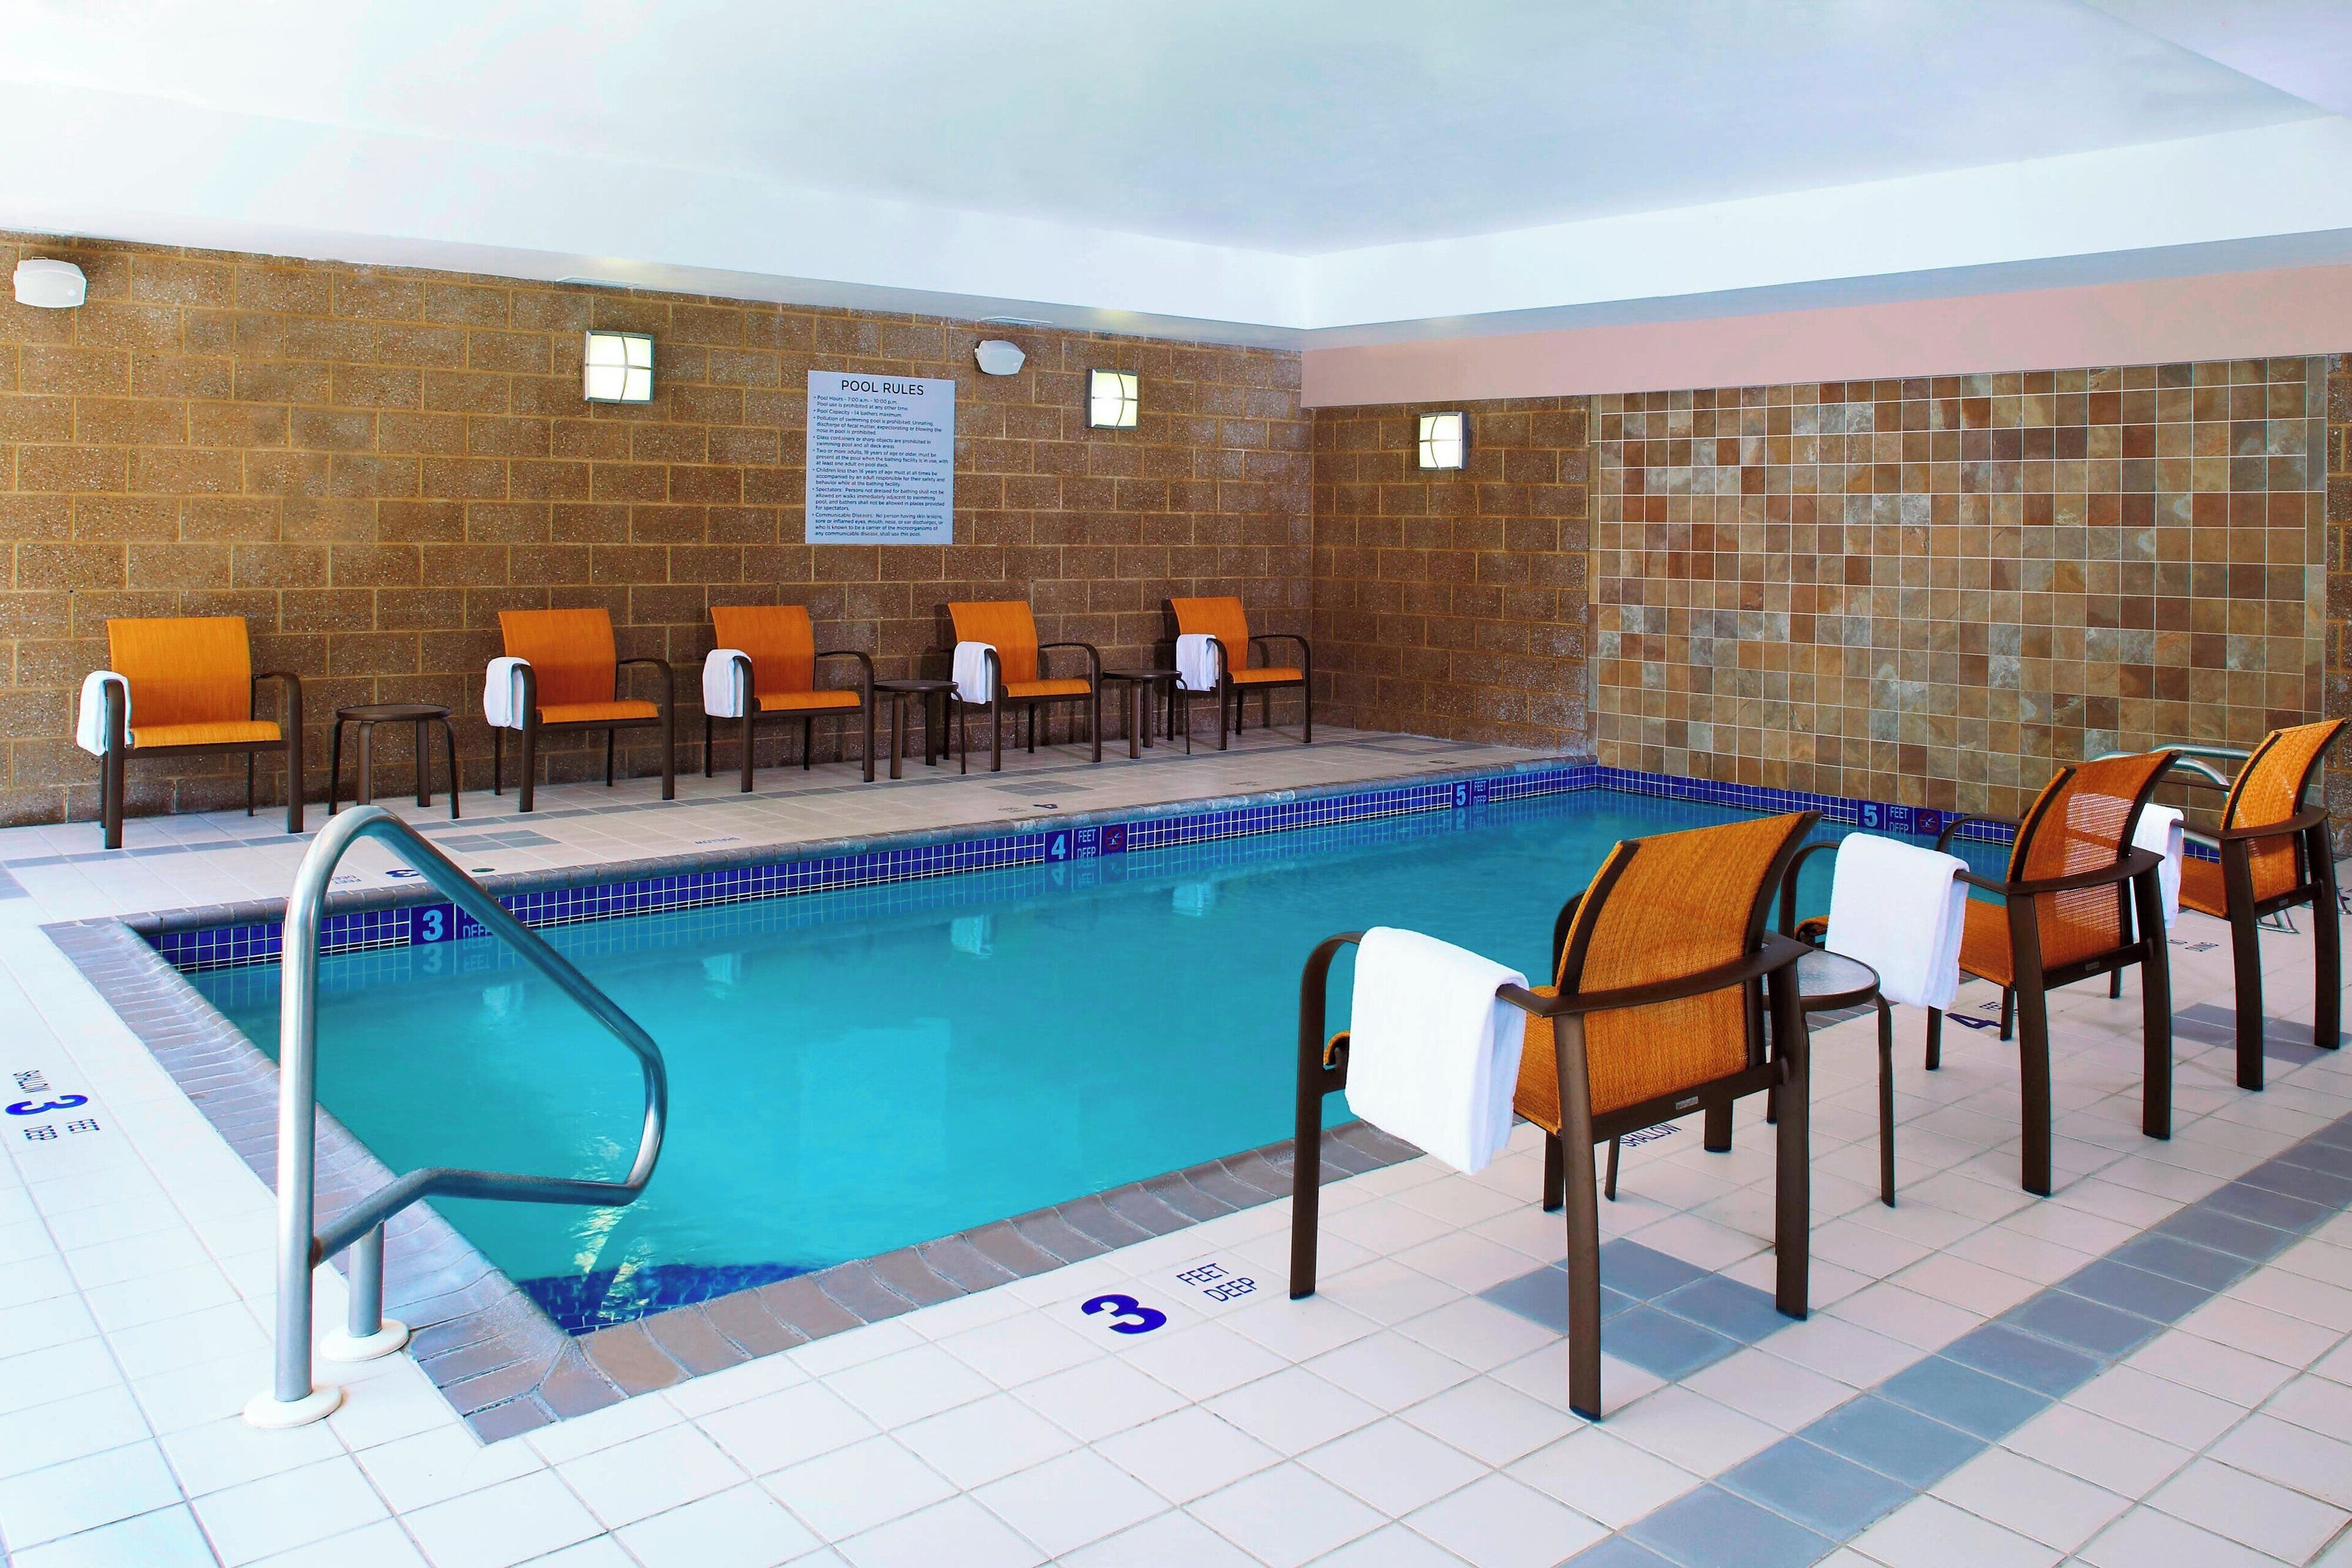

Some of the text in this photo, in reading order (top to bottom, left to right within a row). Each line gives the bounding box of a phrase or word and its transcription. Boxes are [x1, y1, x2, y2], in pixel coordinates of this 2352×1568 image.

[842, 380, 924, 396] POOL RULES
[1457, 785, 1466, 805] 5
[1474, 781, 1487, 792] FEET
[1474, 796, 1487, 805] DEEP
[1864, 805, 1878, 827] 5
[1890, 807, 1909, 820] FEET
[1078, 829, 1096, 843] FEET
[1890, 822, 1909, 833] DEEP
[1051, 835, 1066, 859] 4
[1077, 846, 1096, 859] DEEP
[423, 910, 443, 941] 3
[12, 1070, 52, 1093] SHALLOW
[5, 1095, 88, 1115] 3
[23, 1125, 58, 1141] DEEP
[66, 1118, 100, 1134] FEET
[1620, 1123, 1682, 1147] SHALLOW
[1176, 1262, 1229, 1286] FEET
[1203, 1277, 1257, 1302] DEEP
[1081, 1294, 1167, 1335] 3
